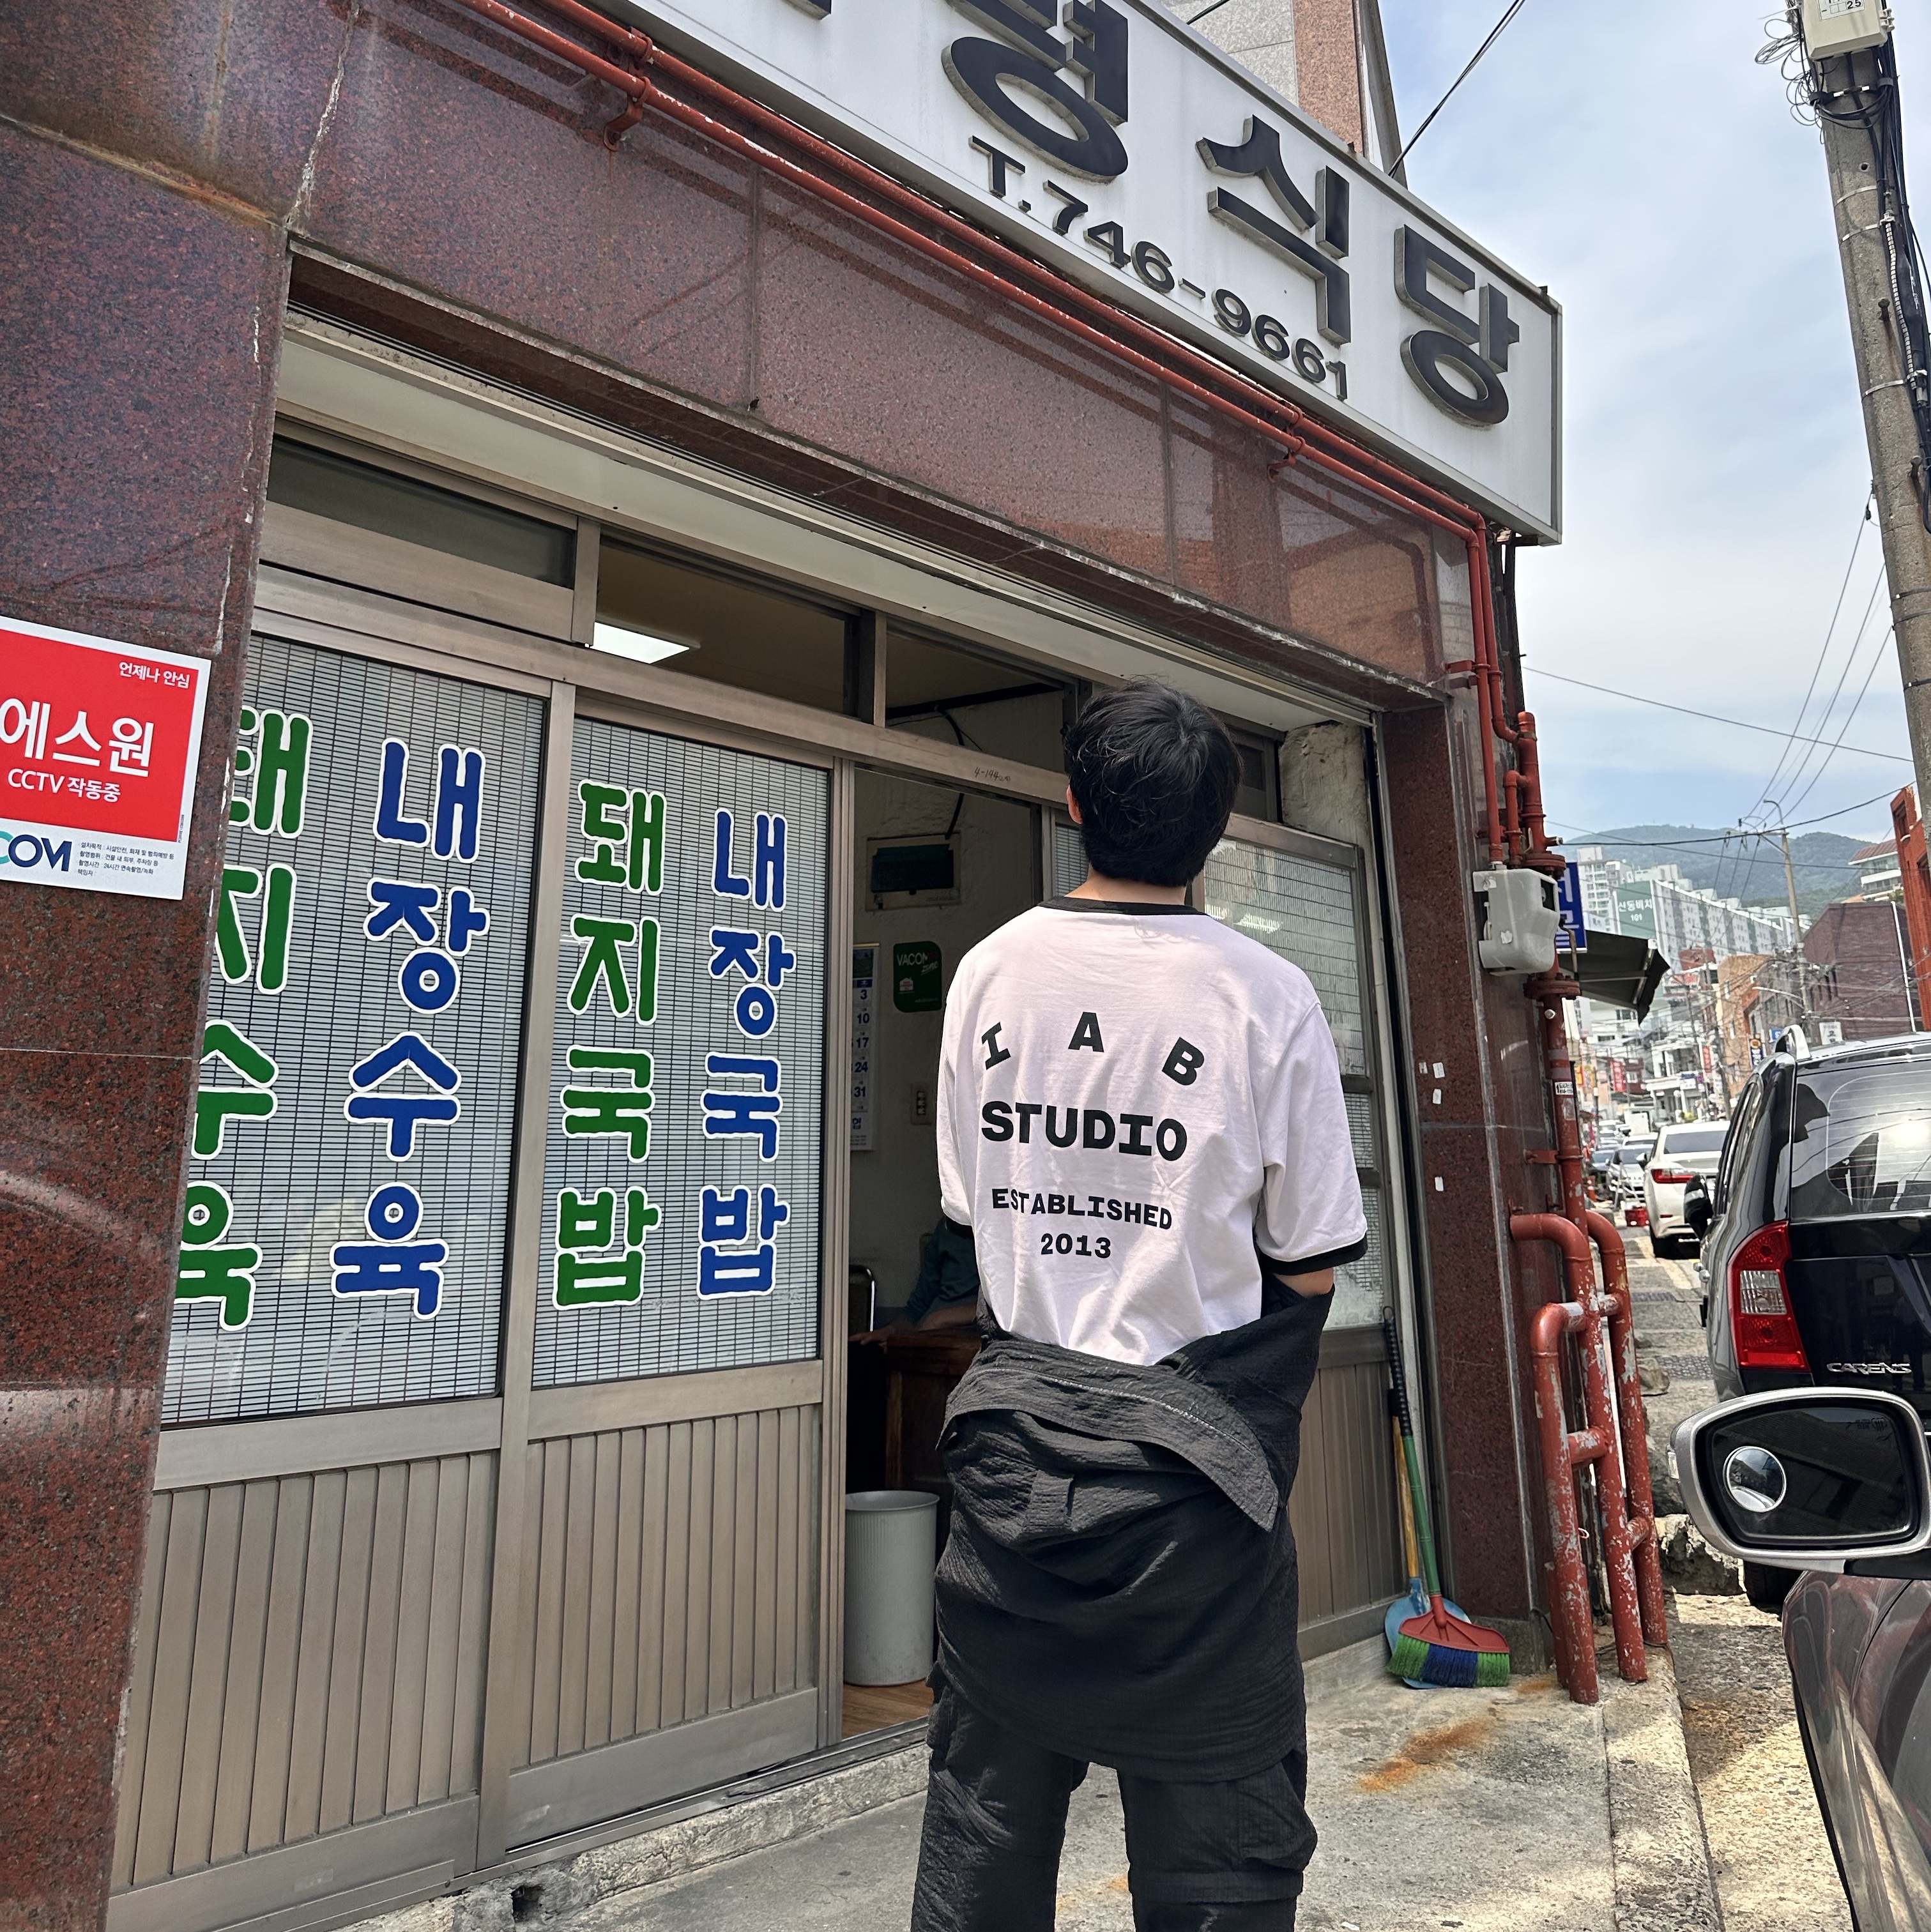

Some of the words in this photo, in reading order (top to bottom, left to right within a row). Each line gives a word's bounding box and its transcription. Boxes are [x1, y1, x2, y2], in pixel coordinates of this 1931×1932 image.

[968, 135, 1348, 401] T.746-9661
[119, 661, 160, 683] 언제나
[163, 670, 190, 689] 안심
[0, 697, 154, 777] 에스원
[8, 768, 65, 793] CCTV
[67, 777, 121, 803] 작동중
[1630, 913, 1643, 922] 101
[860, 989, 867, 1000] 3
[330, 738, 490, 1320] 내장수육
[857, 1013, 870, 1024] 10
[553, 779, 667, 1311] 돼지국밥
[697, 807, 797, 1300] 내장국밥
[857, 1037, 869, 1048] 17
[981, 1022, 1011, 1070] I
[1068, 1011, 1104, 1053] A
[1161, 1037, 1205, 1086] B
[855, 1061, 868, 1073] 24
[854, 1086, 866, 1097] 31
[981, 1100, 1187, 1162] STUDIO
[991, 1187, 1173, 1230] ESTABLISHED
[1041, 1233, 1111, 1259] 2013
[1826, 1362, 1912, 1375] CARENS
